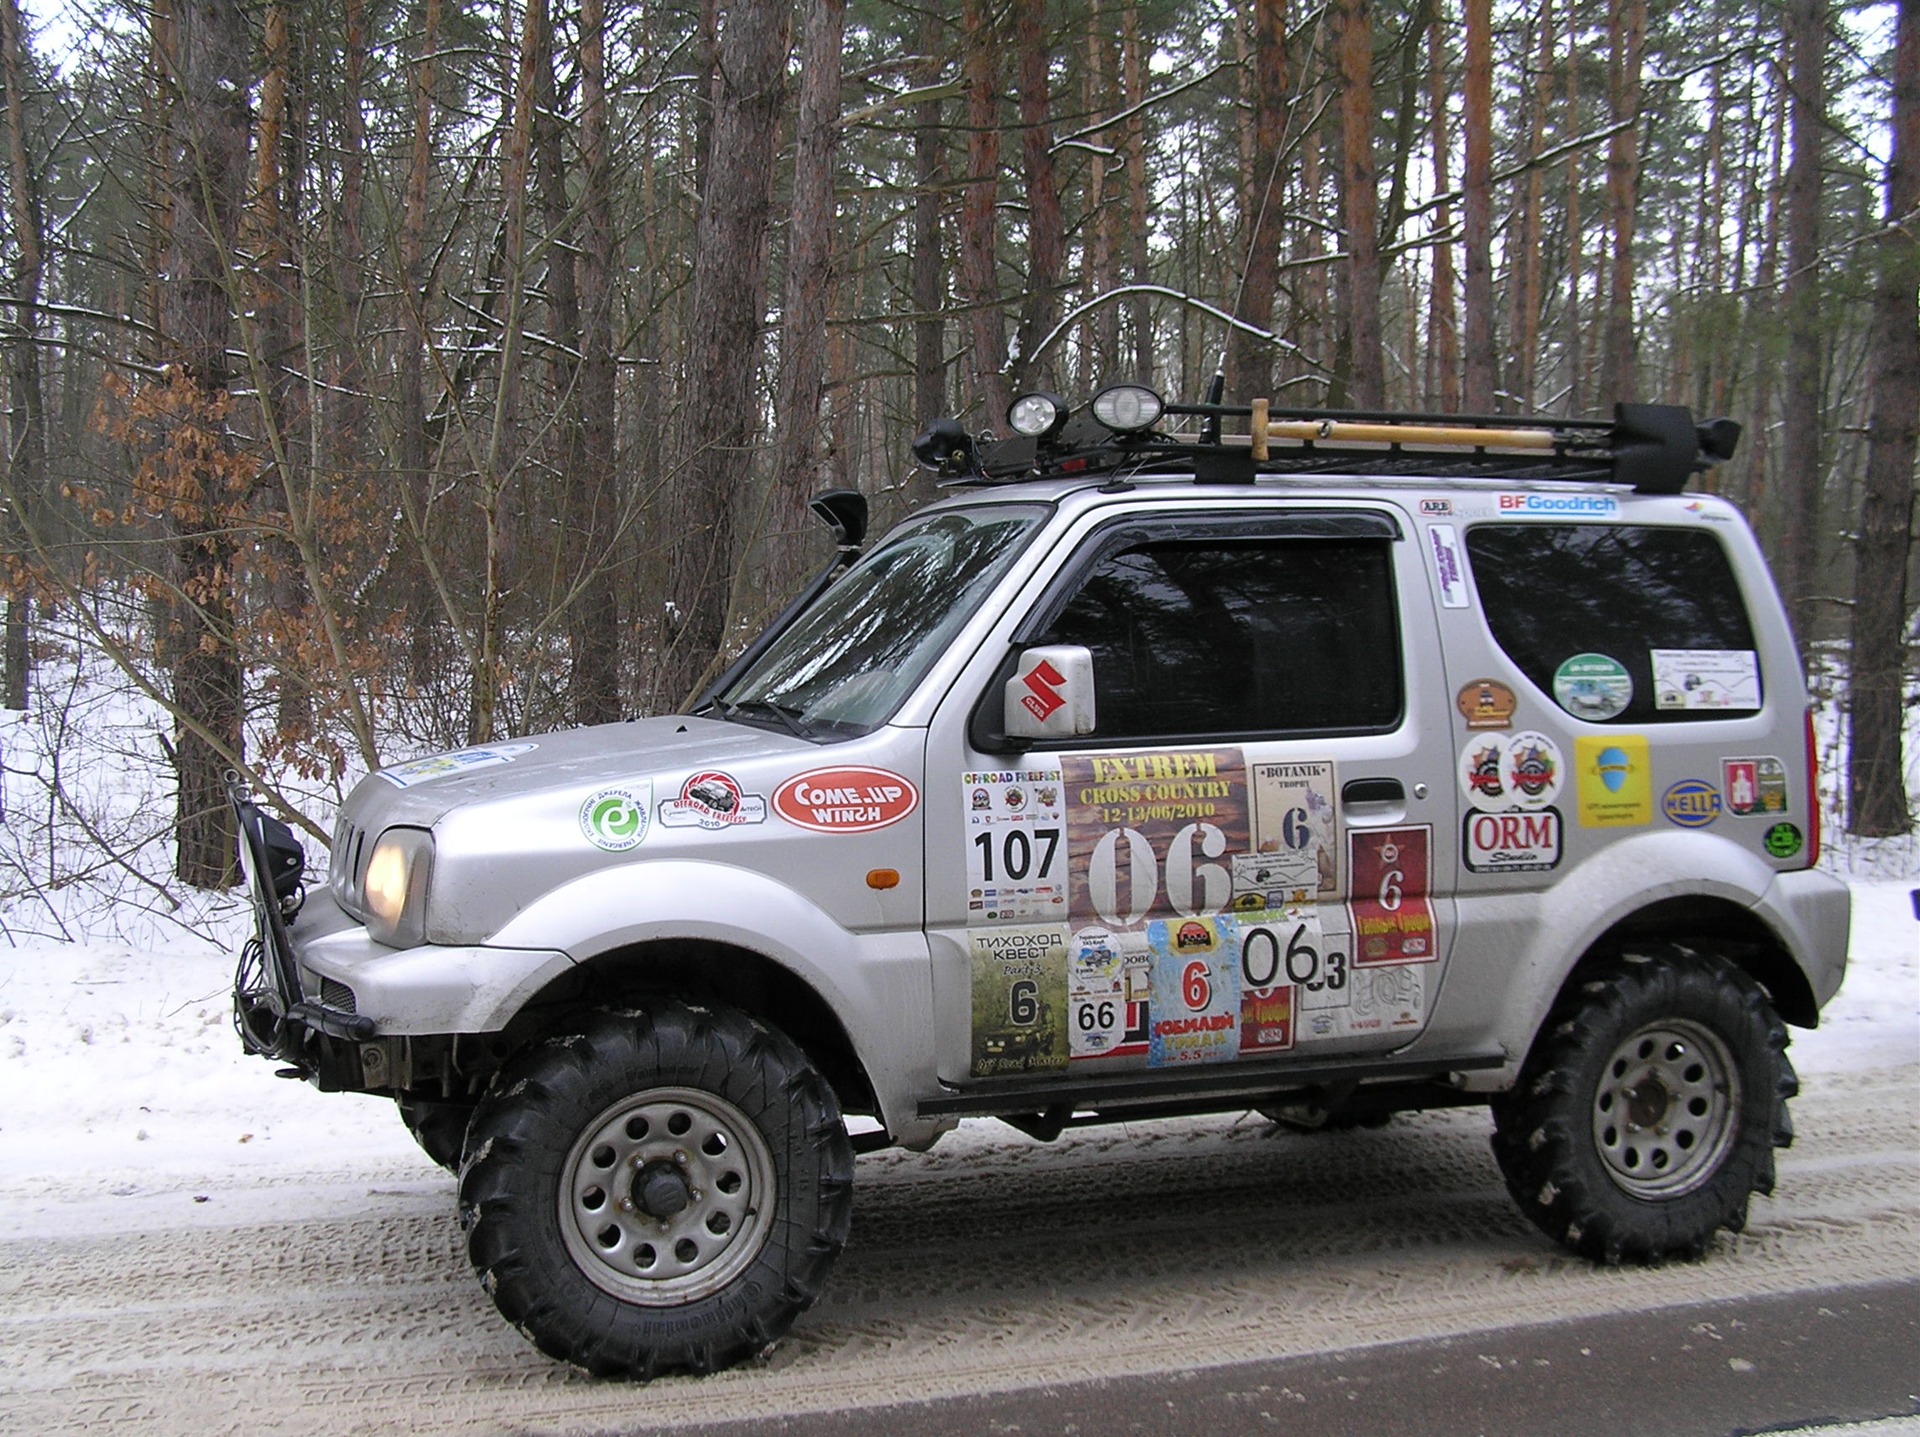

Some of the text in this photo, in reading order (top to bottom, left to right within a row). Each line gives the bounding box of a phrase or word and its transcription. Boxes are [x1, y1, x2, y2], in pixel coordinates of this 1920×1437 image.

[1499, 494, 1617, 511] BFGoodrich
[1025, 697, 1046, 718] CLUB
[964, 770, 1061, 784] OFFROAD FREEFEST
[1091, 752, 1217, 783] EXTREM
[1266, 765, 1321, 778] BOTANIK
[1080, 780, 1231, 805] CROSS COUNTRY
[1278, 780, 1311, 789] TROPHY
[673, 800, 710, 815] OFFROAD
[811, 807, 881, 824] WINCH
[1102, 802, 1216, 823] 12-13/06/2010
[700, 818, 720, 827] 2010
[1283, 807, 1311, 850] 6
[1474, 816, 1553, 851] ORM
[975, 828, 1060, 882] 107
[1489, 852, 1538, 863] Studio
[1088, 823, 1232, 926] 06
[1379, 870, 1404, 911] 6
[976, 933, 1064, 948] ТИХОХОД
[993, 946, 1050, 961] КВЕСТ
[1243, 924, 1319, 986] 06
[1183, 960, 1212, 1012] 6
[1010, 979, 1039, 1026] 6
[1078, 1001, 1115, 1031] 66
[1180, 1051, 1201, 1061] 5.5
